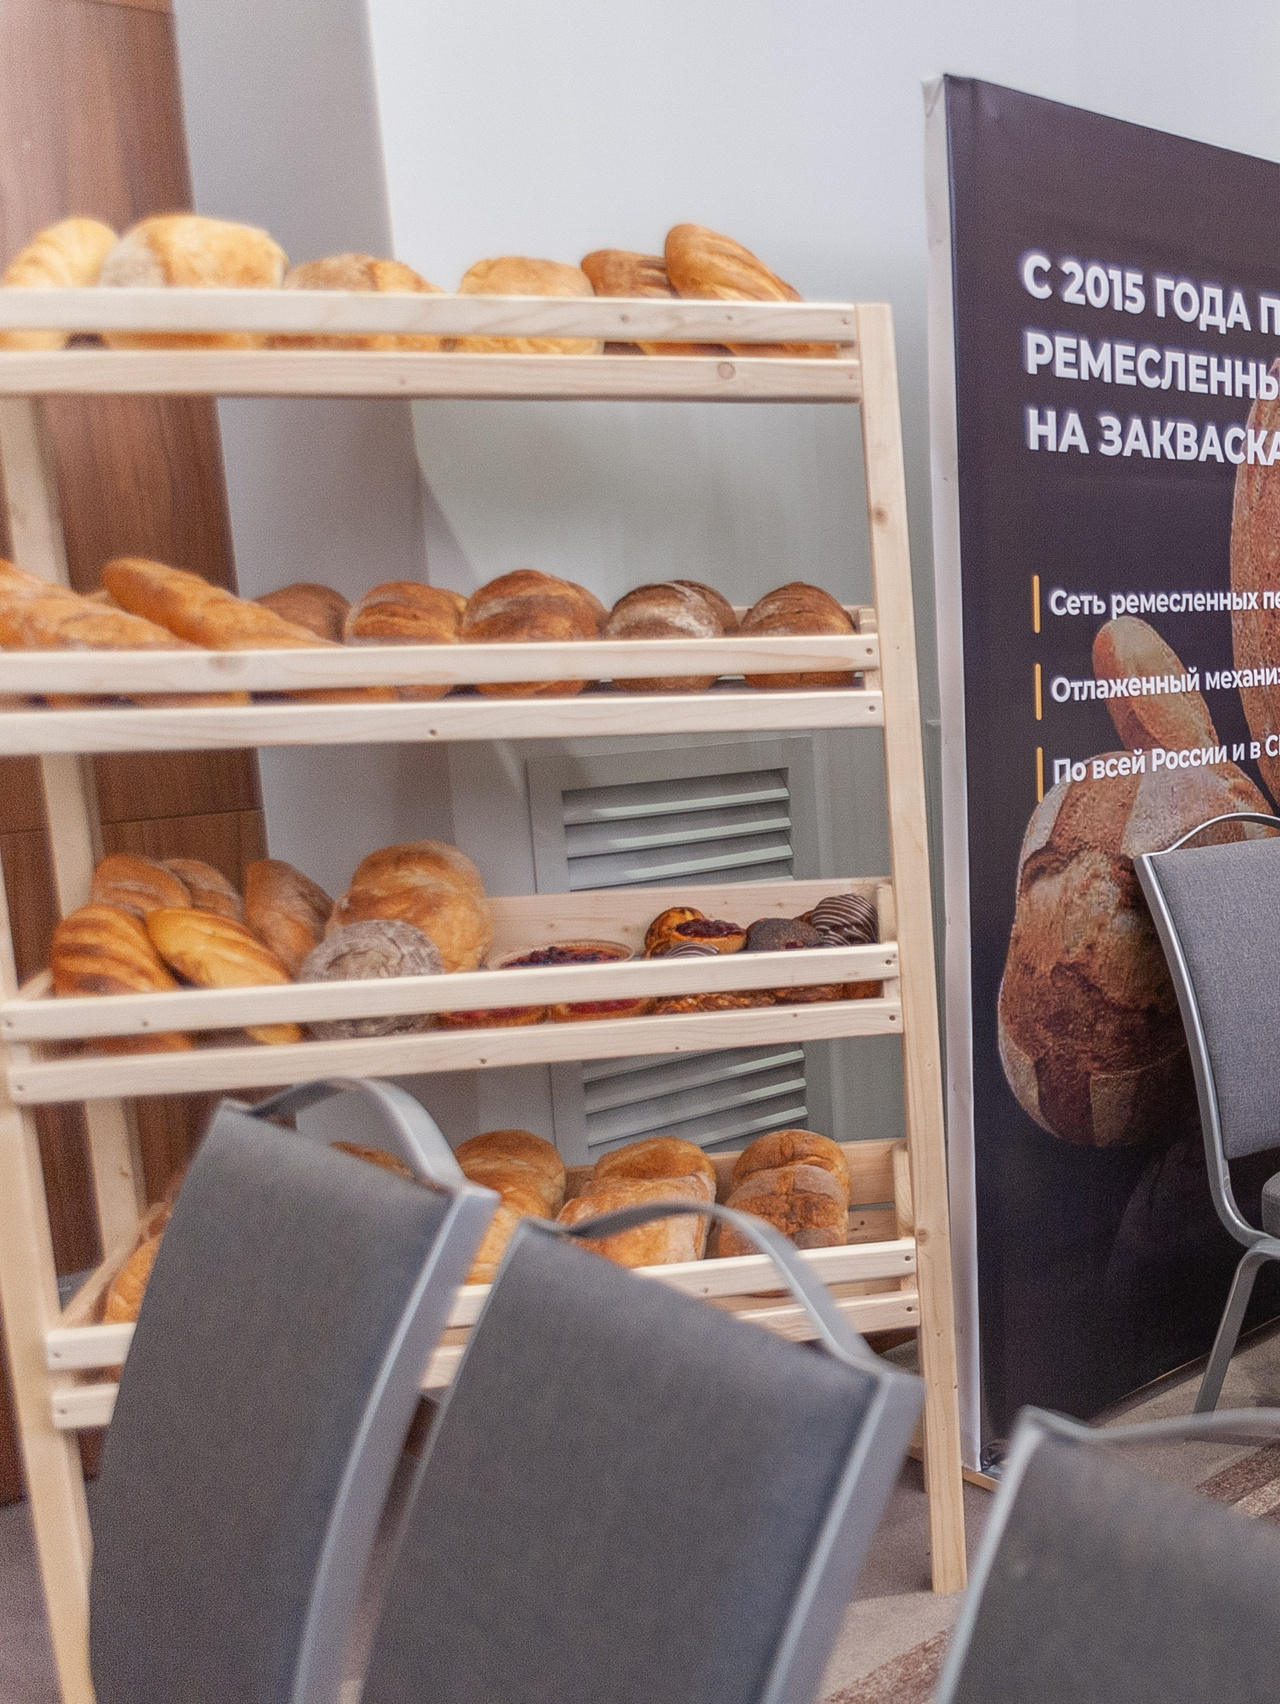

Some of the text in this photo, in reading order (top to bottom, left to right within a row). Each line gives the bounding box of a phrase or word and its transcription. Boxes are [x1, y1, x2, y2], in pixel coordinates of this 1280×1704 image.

[1023, 255, 1052, 299] С
[1061, 261, 1146, 314] 2015
[1156, 277, 1251, 334] ГОДА
[1028, 409, 1089, 453] НА
[1050, 590, 1106, 616] Сеть
[1112, 592, 1258, 620] ремесленных
[1052, 667, 1200, 702] Отлаженный
[1053, 758, 1086, 784] По
[1092, 748, 1146, 779] всей
[1152, 745, 1228, 772] России
[1232, 744, 1245, 761] и
[1250, 741, 1261, 760] в
